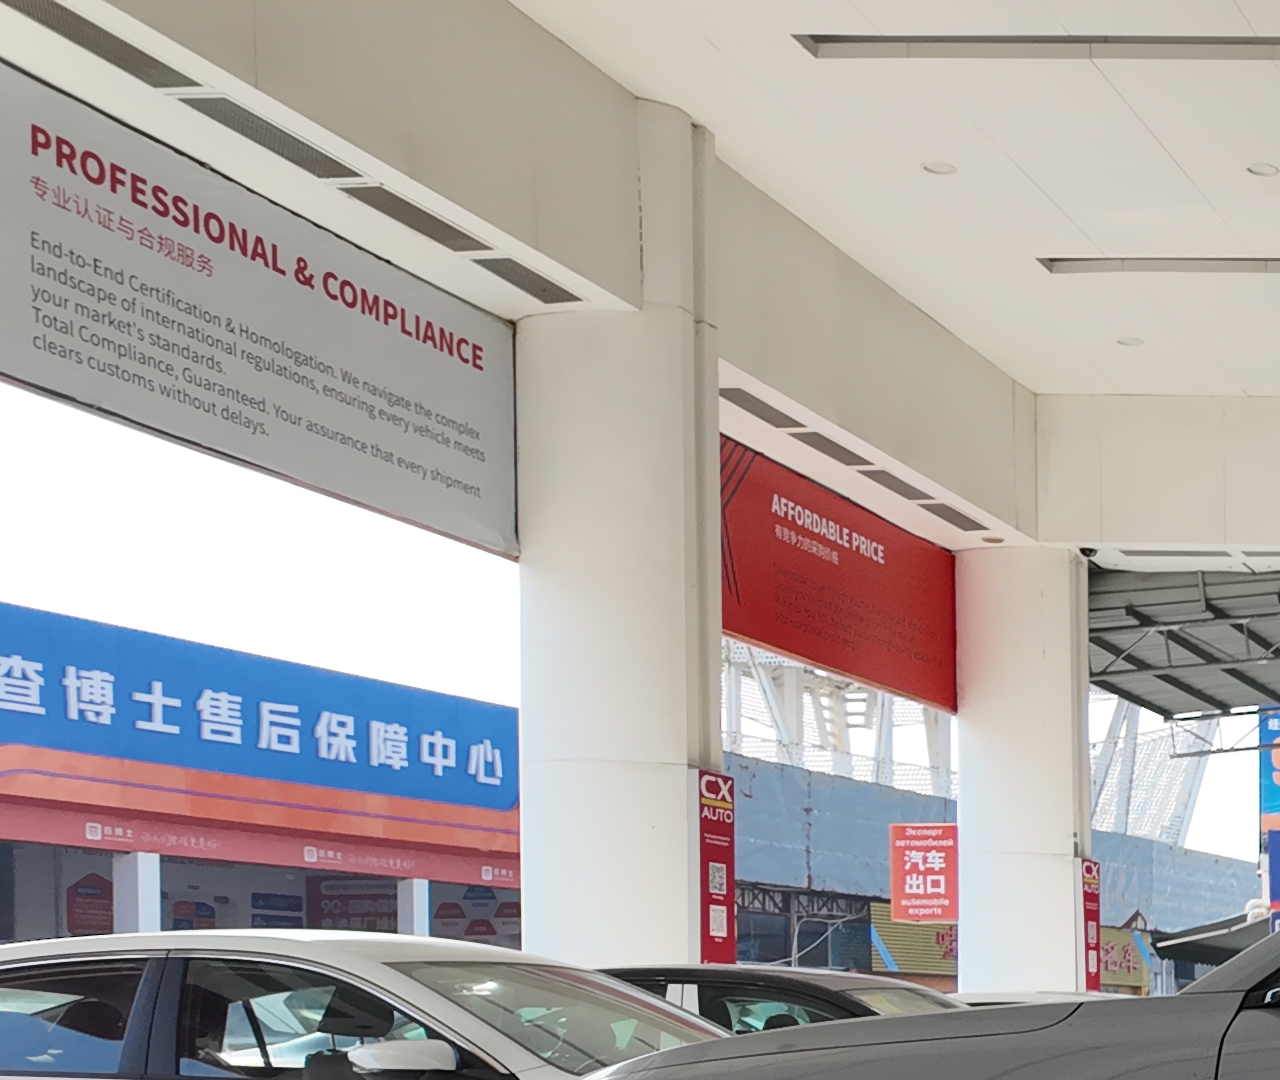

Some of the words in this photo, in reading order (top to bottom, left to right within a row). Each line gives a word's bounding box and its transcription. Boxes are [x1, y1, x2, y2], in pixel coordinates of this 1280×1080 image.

[30, 175, 214, 278] 专业认证与合规服务
[30, 123, 287, 277] PROFESSIONAL
[294, 257, 315, 290] &
[322, 271, 484, 371] COMPLIANCE
[30, 284, 70, 310] your
[75, 301, 145, 341] market's
[149, 333, 227, 376] standards.
[31, 231, 124, 286] End-to-End
[128, 275, 221, 328] Certification
[225, 318, 236, 334] &
[239, 323, 338, 379] Homologation.
[340, 368, 360, 389] We
[362, 381, 412, 412] navigate
[414, 402, 433, 420] the
[435, 411, 481, 441] complex
[31, 255, 117, 306] landscape
[121, 298, 137, 314] of
[141, 303, 237, 357] international
[241, 348, 320, 395] regulations,
[322, 384, 376, 420] ensuring
[378, 407, 411, 433] every
[412, 419, 451, 448] vehicle
[454, 439, 486, 462] meets
[32, 306, 74, 337] Total
[78, 325, 179, 381] Compliance,
[181, 366, 271, 416] Guaranteed.
[273, 403, 302, 427] Your
[306, 419, 368, 454] assurance
[370, 444, 395, 465] that
[396, 456, 428, 480] every
[430, 468, 481, 498] shipment
[33, 334, 83, 365] clears
[87, 356, 155, 392] customs
[158, 383, 217, 417] without
[221, 405, 270, 436] delays.
[771, 494, 850, 548] AFFORDABLE
[852, 532, 885, 564] PRICE
[0, 655, 503, 786] 查博士售后保障中心
[701, 774, 733, 803] CX
[702, 806, 733, 824] AUTO
[904, 850, 946, 871] 汽车
[904, 873, 946, 894] 出口
[1082, 861, 1099, 879] CX
[908, 907, 942, 917] exports
